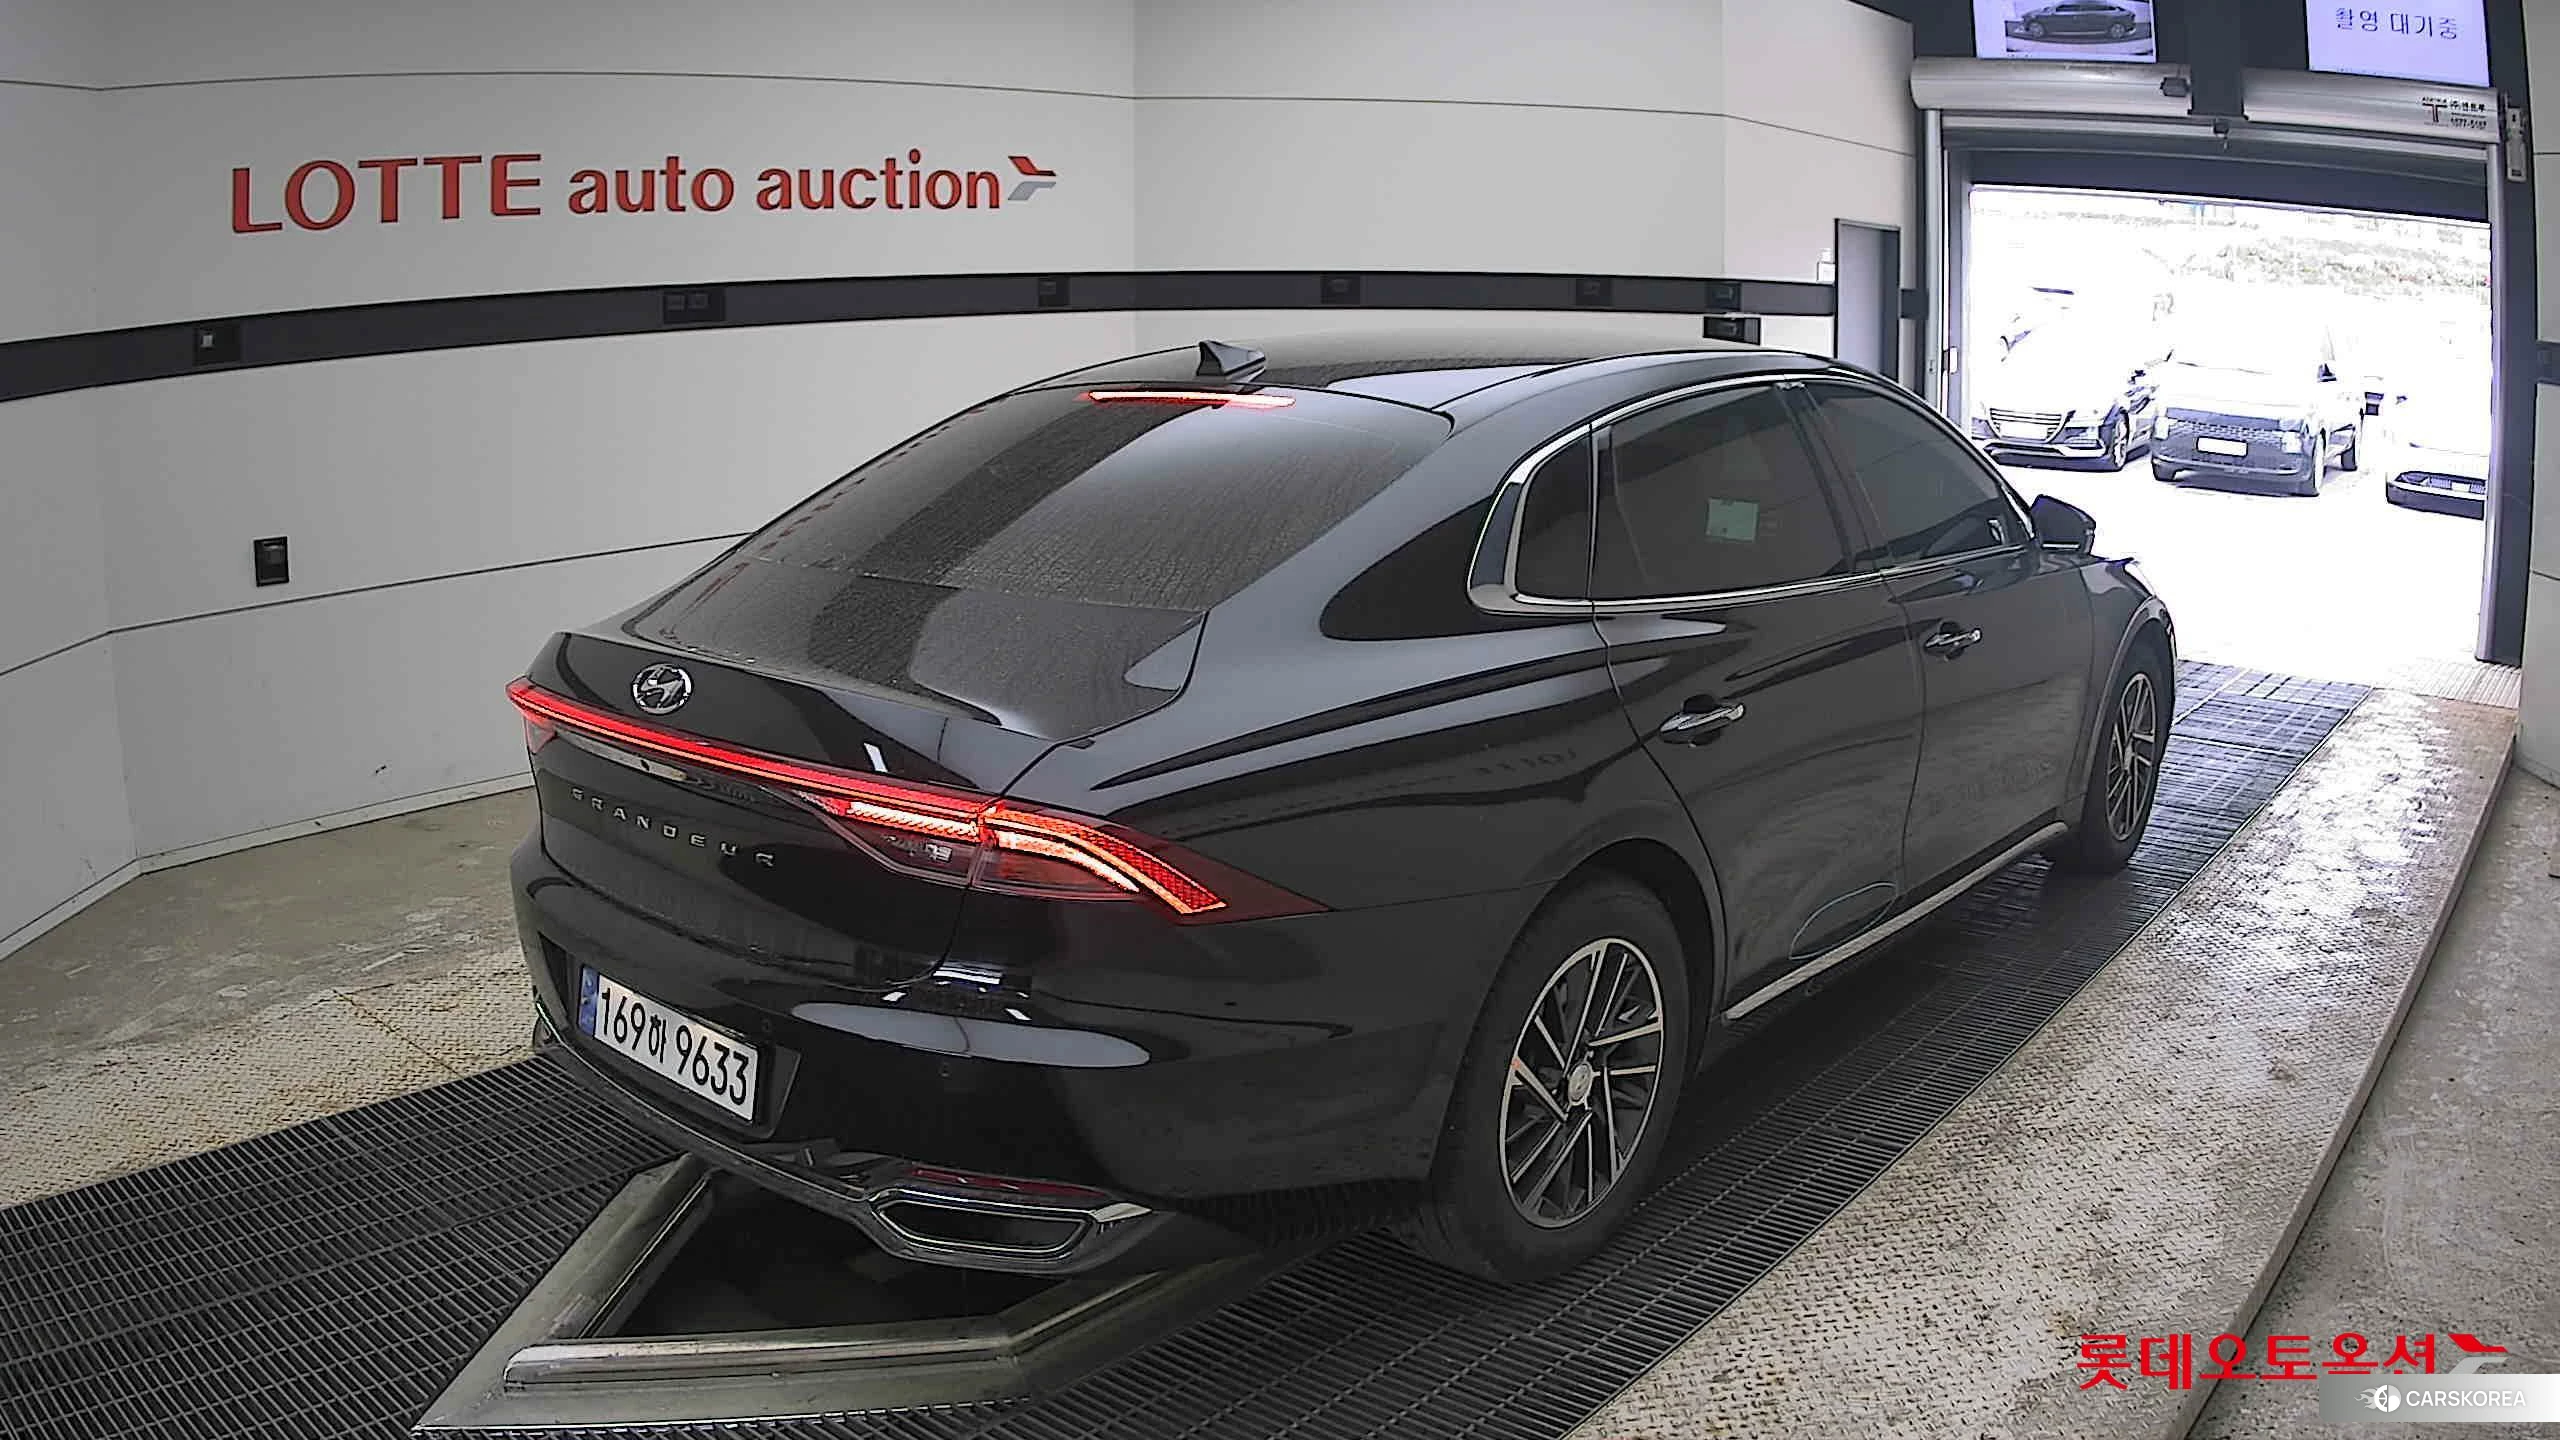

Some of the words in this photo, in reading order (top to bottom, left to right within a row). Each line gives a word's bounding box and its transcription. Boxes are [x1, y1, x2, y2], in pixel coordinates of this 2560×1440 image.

[2390, 13, 2457, 40] 대기중
[231, 152, 543, 234] LOTTE
[568, 157, 735, 214] auto
[756, 149, 1001, 212] auction
[571, 788, 774, 867] GRANDEUR
[601, 987, 668, 1064] 169하
[675, 1024, 750, 1106] 9633
